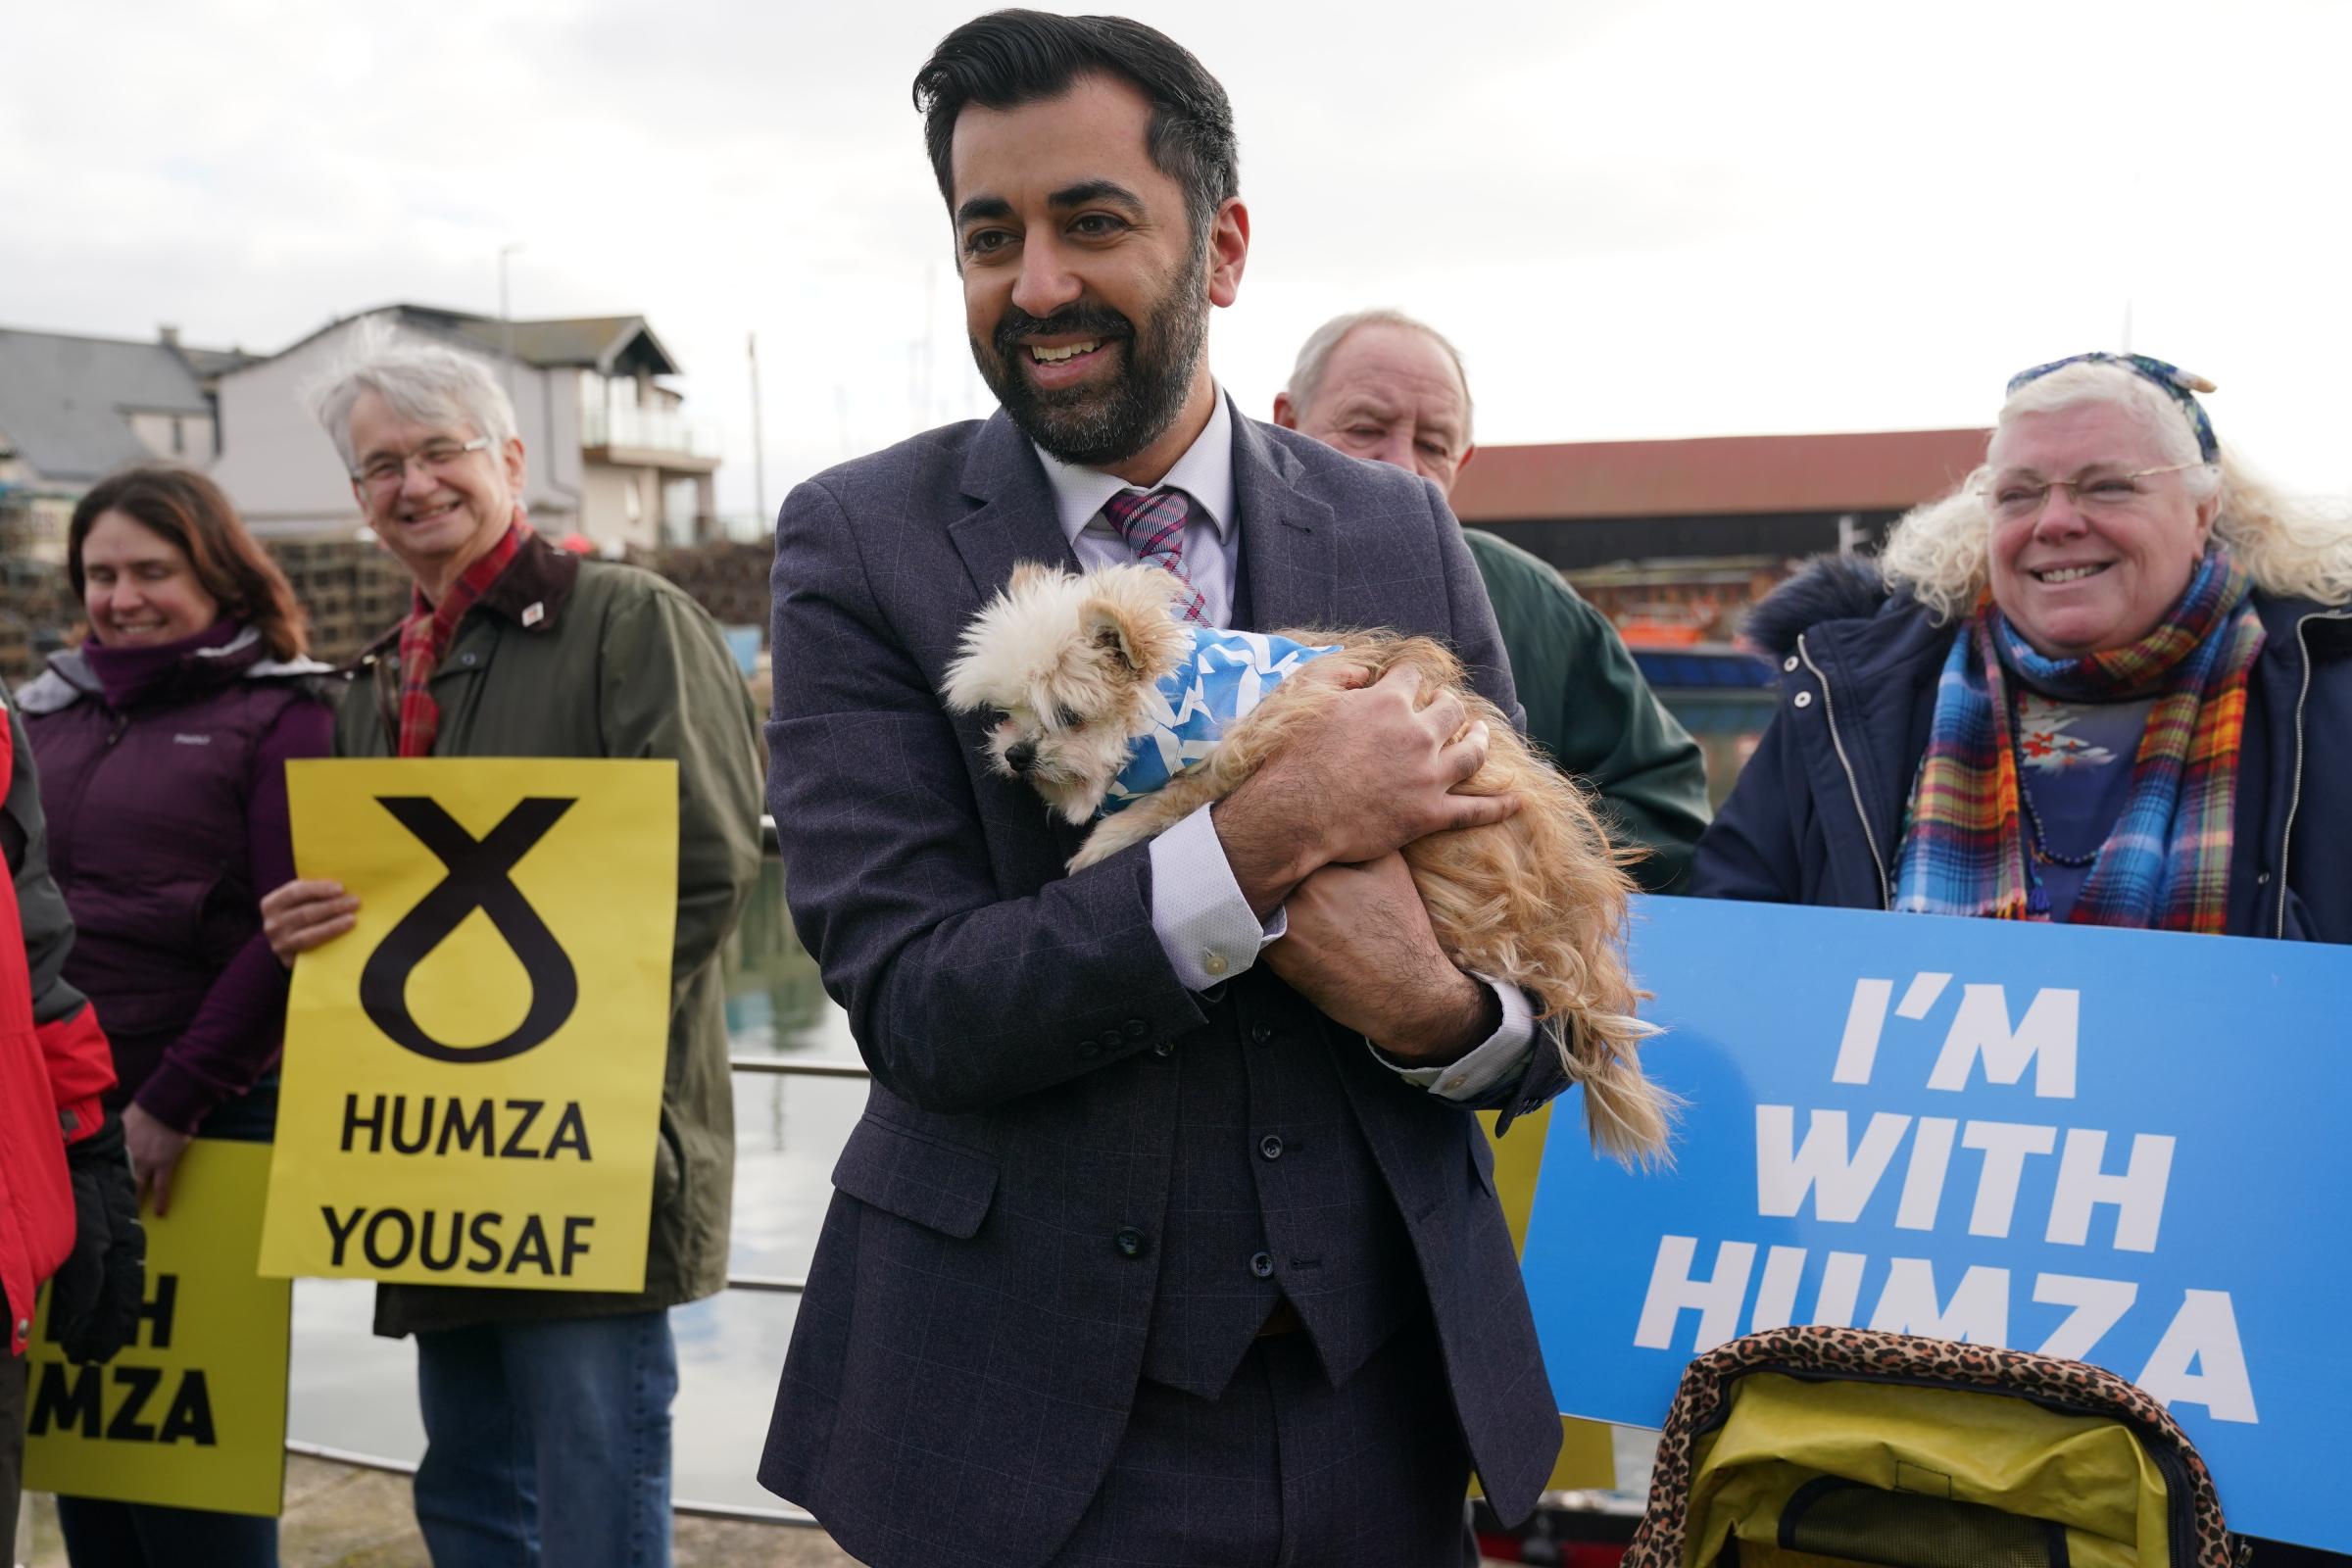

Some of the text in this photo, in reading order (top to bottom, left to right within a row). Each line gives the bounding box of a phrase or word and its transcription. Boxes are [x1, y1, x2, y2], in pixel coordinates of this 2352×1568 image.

[1831, 971, 2081, 1100] I'M
[340, 1093, 592, 1161] HUMZA
[1755, 1103, 2177, 1253] WITH
[320, 1205, 595, 1277] YOUSAF
[24, 1359, 217, 1446] MZA
